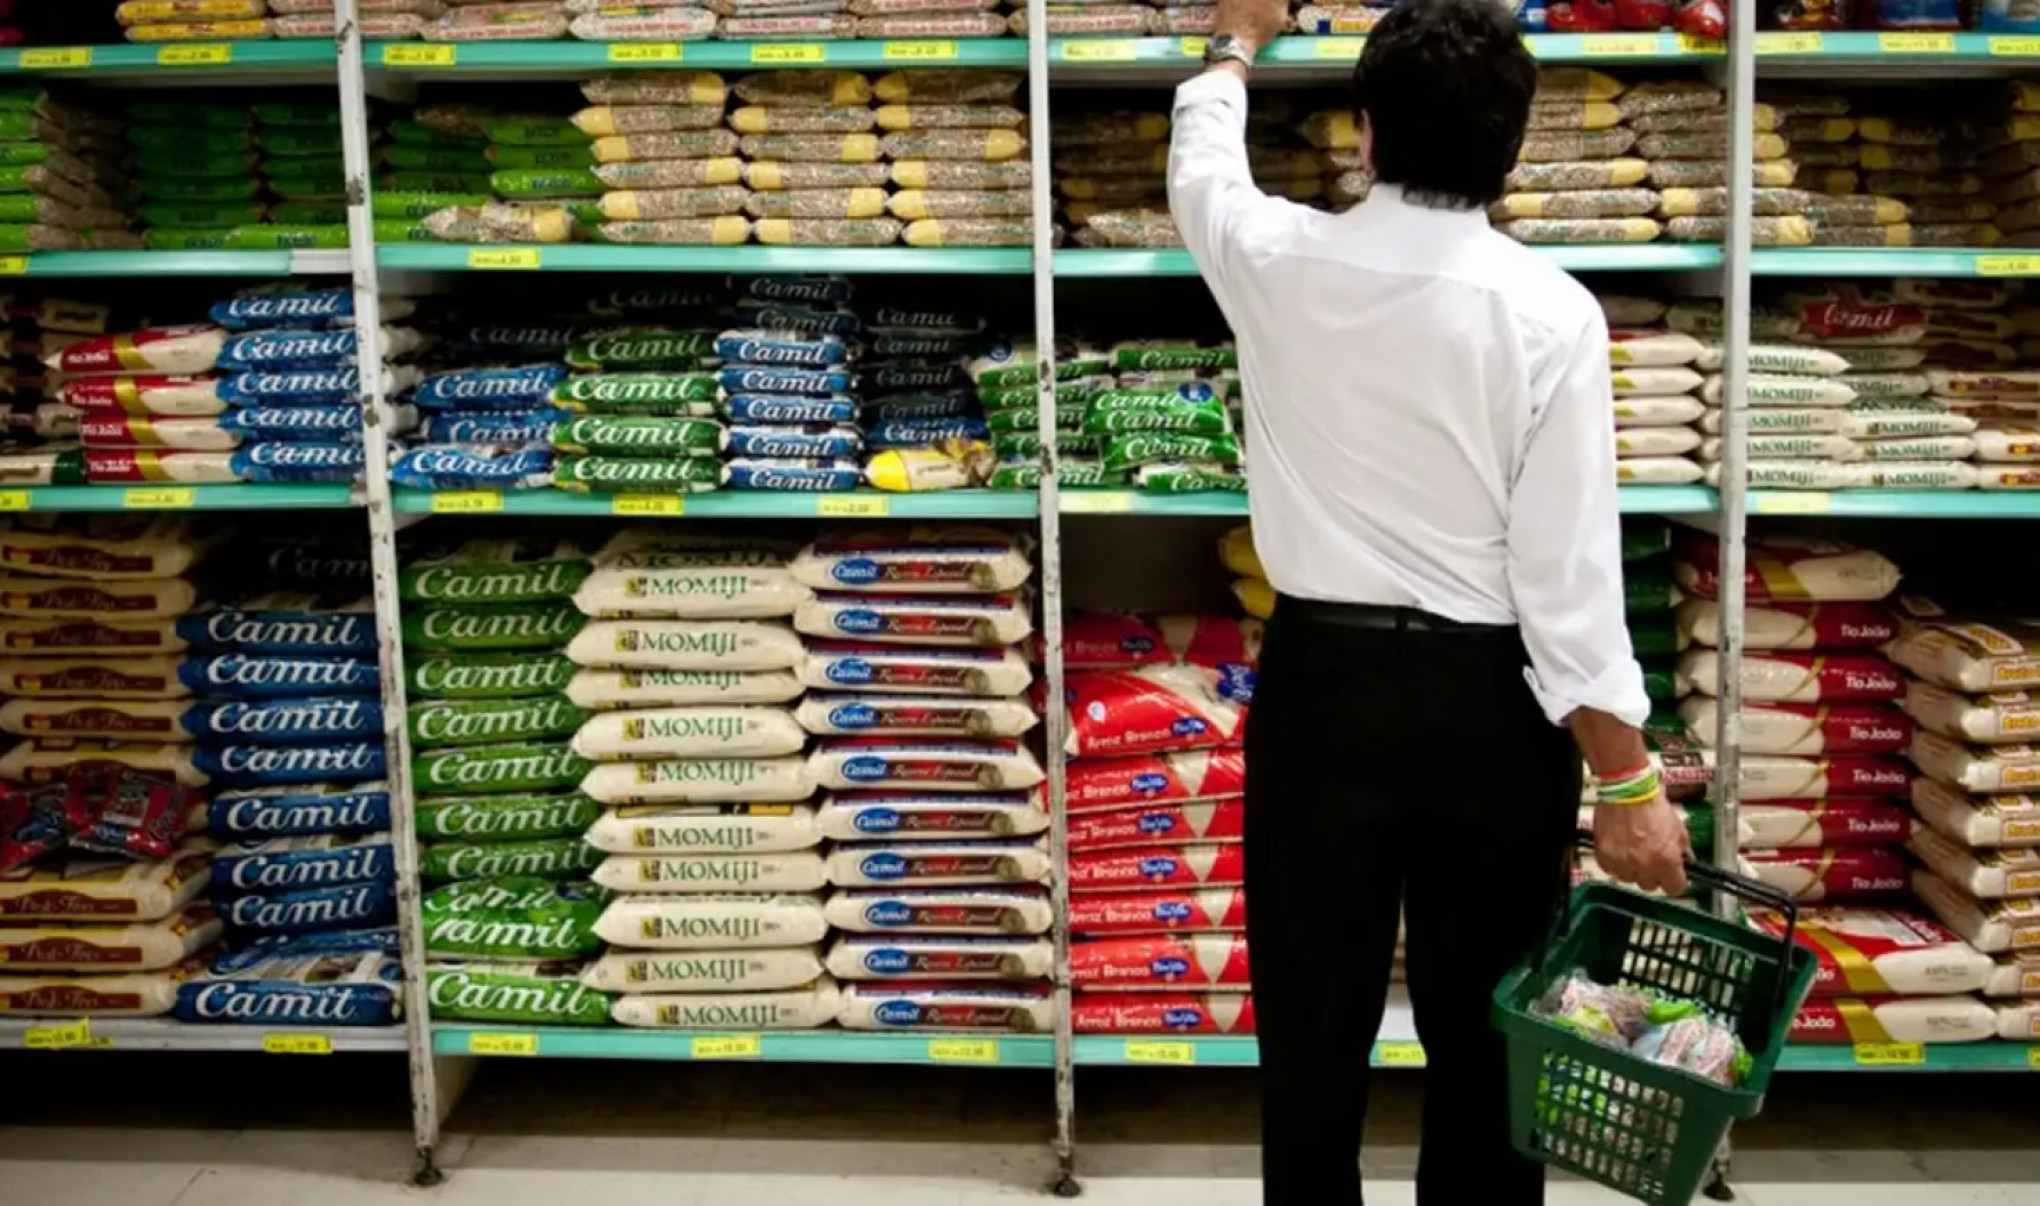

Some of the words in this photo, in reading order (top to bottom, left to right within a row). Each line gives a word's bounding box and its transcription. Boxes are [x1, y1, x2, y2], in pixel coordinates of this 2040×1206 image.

[750, 277, 832, 300] Camil
[228, 292, 340, 317] Camil
[755, 309, 838, 332] Camil
[1824, 305, 1895, 328] Camil
[233, 329, 353, 361] Camil
[588, 335, 700, 361] Camil
[739, 341, 825, 363] Camil
[1140, 351, 1223, 368] Camil
[238, 369, 360, 394] Camil
[435, 373, 544, 398] Camil
[571, 376, 693, 401] Camil
[742, 368, 830, 392] Camil
[237, 404, 357, 427] Camil
[747, 396, 834, 420] Camil
[572, 419, 693, 444] Camil
[1105, 409, 1197, 431] Camil
[746, 431, 832, 456] Camil
[412, 450, 528, 475] Camil
[574, 456, 695, 480] Camil
[750, 466, 837, 490] Camil
[1754, 469, 1814, 485] MOMIJI
[415, 564, 566, 598] Camil
[834, 565, 878, 578] Camil
[650, 576, 747, 599] MOMIJI
[207, 611, 360, 645] Camil
[423, 607, 572, 638] Camil
[836, 615, 880, 628] Camil
[1840, 624, 1863, 639] Tio
[641, 633, 737, 656] MOMIJI
[207, 653, 360, 684] Camil
[416, 653, 562, 690] Camil
[644, 670, 742, 690] MOMIJI
[828, 666, 872, 679] Camil
[1845, 675, 1868, 690] Tio
[209, 700, 364, 733] Camil
[417, 700, 566, 739] Camil
[831, 712, 874, 723] Camil
[648, 718, 743, 741] MOMIJI
[1850, 726, 1872, 740] Tio
[220, 743, 372, 771] Camil
[430, 748, 577, 785] Camil
[660, 762, 755, 785] MOMIJI
[843, 763, 886, 776] Camil
[1853, 770, 1876, 783] Tio
[227, 796, 374, 831] Camil
[435, 798, 584, 835] Camil
[857, 816, 899, 828] Camil
[1848, 819, 1870, 833] Tio
[657, 828, 754, 849] MOMIJI
[232, 848, 380, 889] Camil
[447, 838, 595, 878] Camil
[864, 861, 905, 873] Camil
[663, 861, 759, 884] MOMIJI
[1852, 877, 1874, 890] Tio
[232, 887, 373, 927] Camil
[868, 909, 910, 921] Camil
[665, 918, 760, 940] MOMIJI
[651, 959, 746, 982] MOMIJI
[868, 956, 909, 967] Camil
[196, 981, 354, 1020] Camil
[430, 972, 590, 1015] Camil
[683, 1005, 778, 1026] MOMIJI
[878, 1008, 920, 1020] Camil
